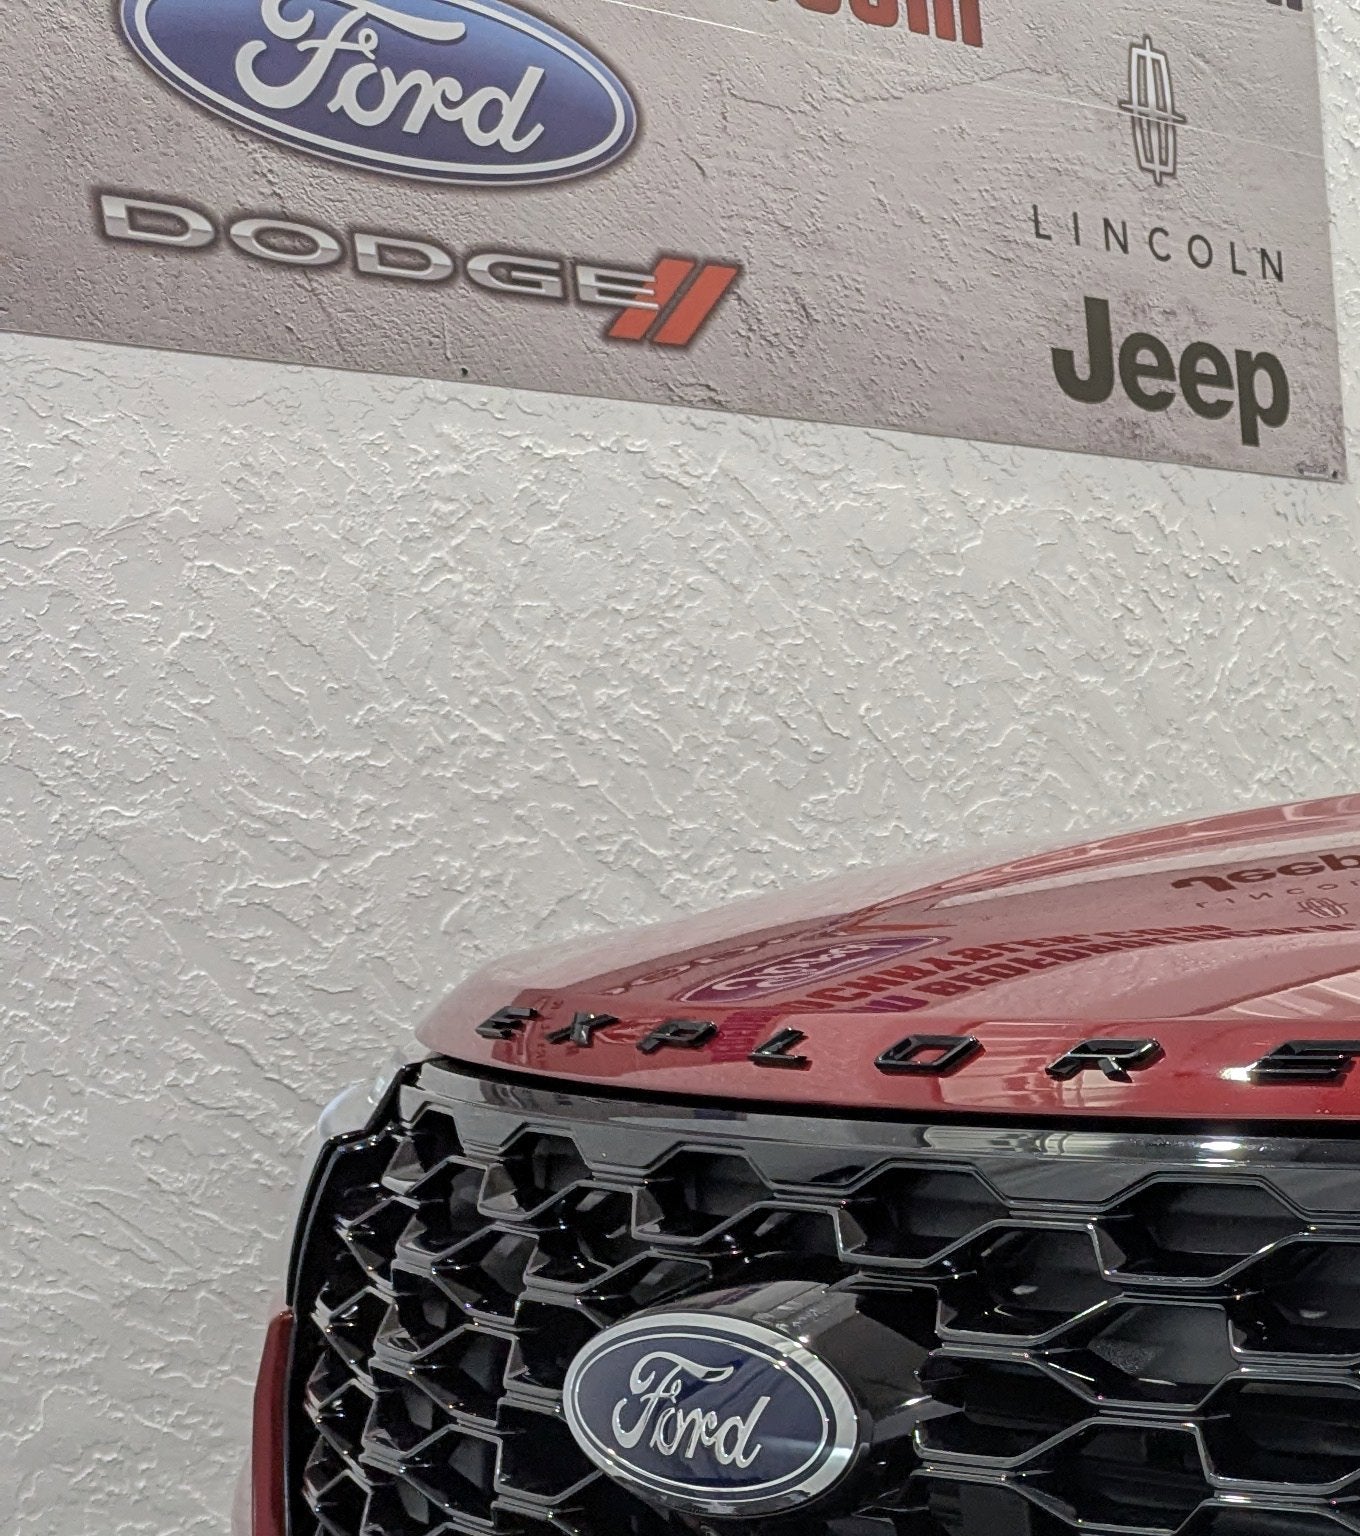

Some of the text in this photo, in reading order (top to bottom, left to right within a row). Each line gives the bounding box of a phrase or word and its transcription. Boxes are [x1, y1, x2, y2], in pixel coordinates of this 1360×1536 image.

[235, 0, 545, 153] Ford
[102, 195, 659, 311] DODGE
[1032, 203, 1284, 283] LINCOLN
[1050, 296, 1291, 447] Jeep
[612, 1350, 771, 1469] Ford
